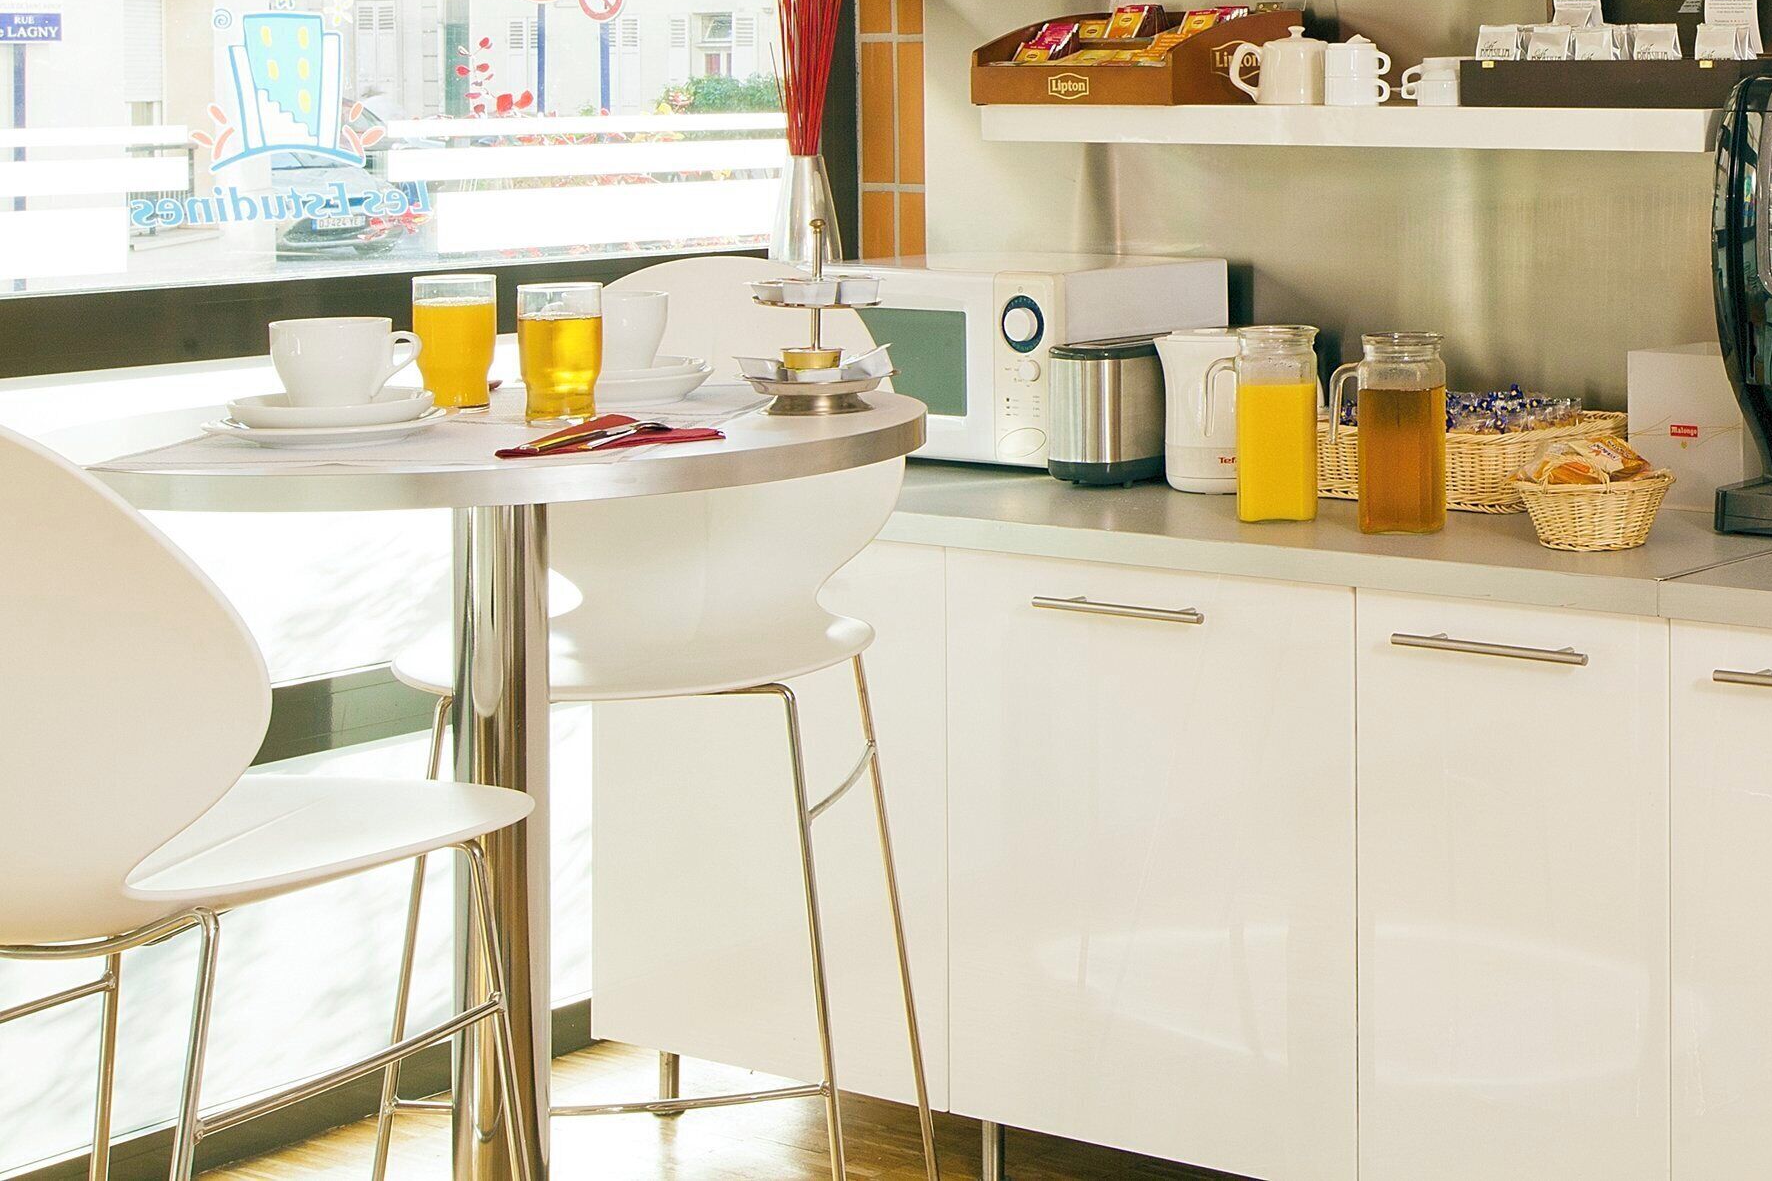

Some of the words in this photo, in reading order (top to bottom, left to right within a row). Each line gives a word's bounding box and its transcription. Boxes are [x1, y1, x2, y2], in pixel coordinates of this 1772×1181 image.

[14, 16, 35, 25] RUE
[7, 26, 59, 38] LAGNY
[1051, 79, 1086, 94] Lipton
[1671, 426, 1698, 437] Malongo
[1218, 456, 1236, 464] Tef
